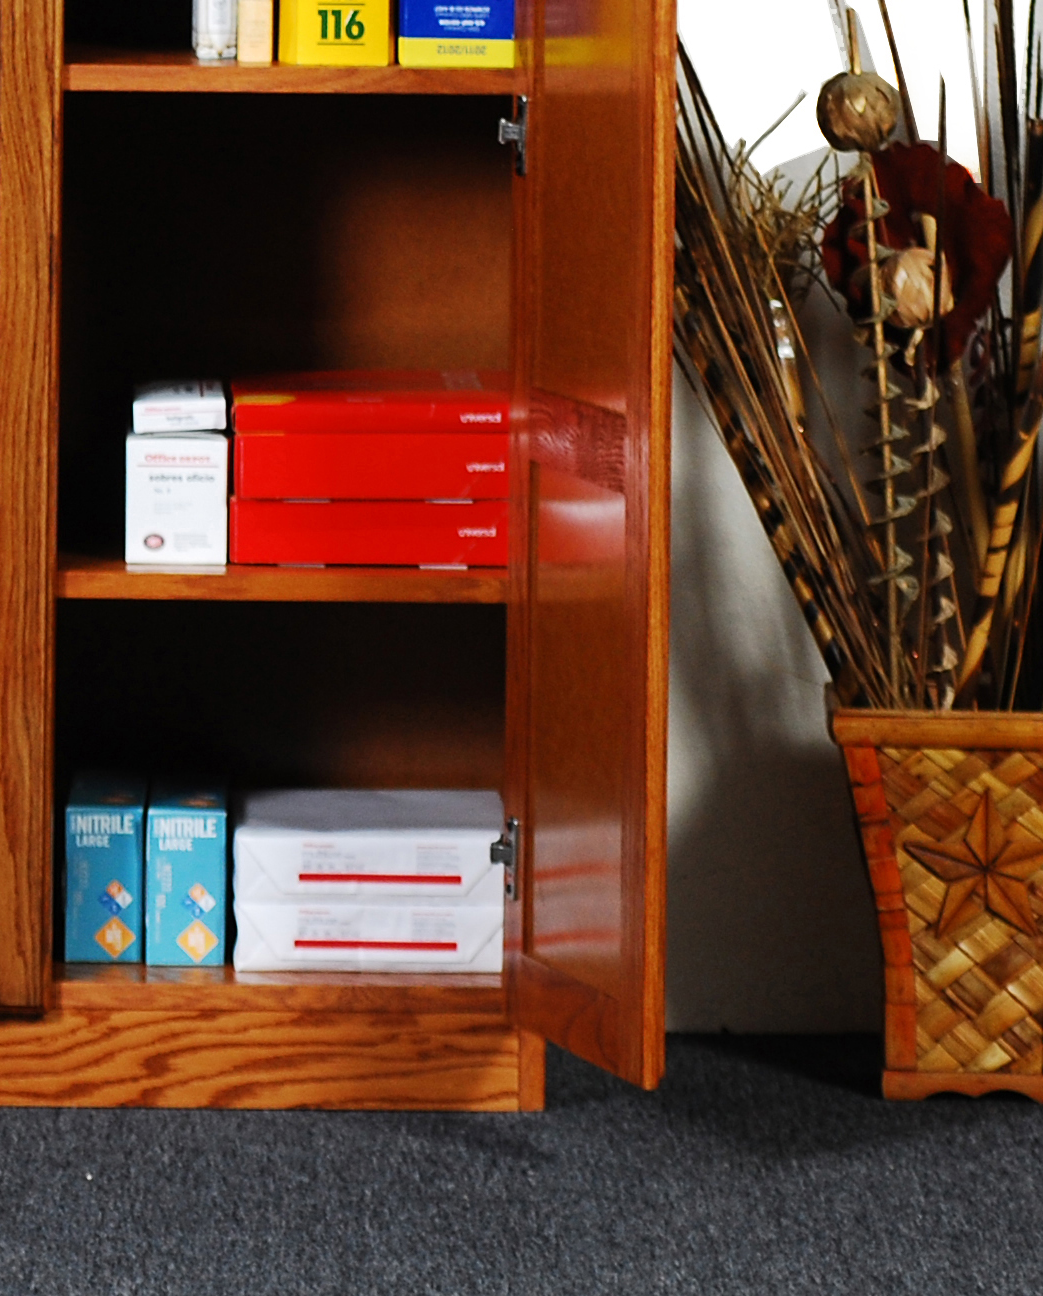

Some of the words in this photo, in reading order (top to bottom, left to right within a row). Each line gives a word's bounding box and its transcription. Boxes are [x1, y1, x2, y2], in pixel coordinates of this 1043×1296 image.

[317, 10, 366, 40] 116
[75, 813, 135, 835] NITRILE
[159, 818, 218, 838] NITRILE
[75, 835, 111, 848] LARGE
[159, 838, 194, 851] LARGE
